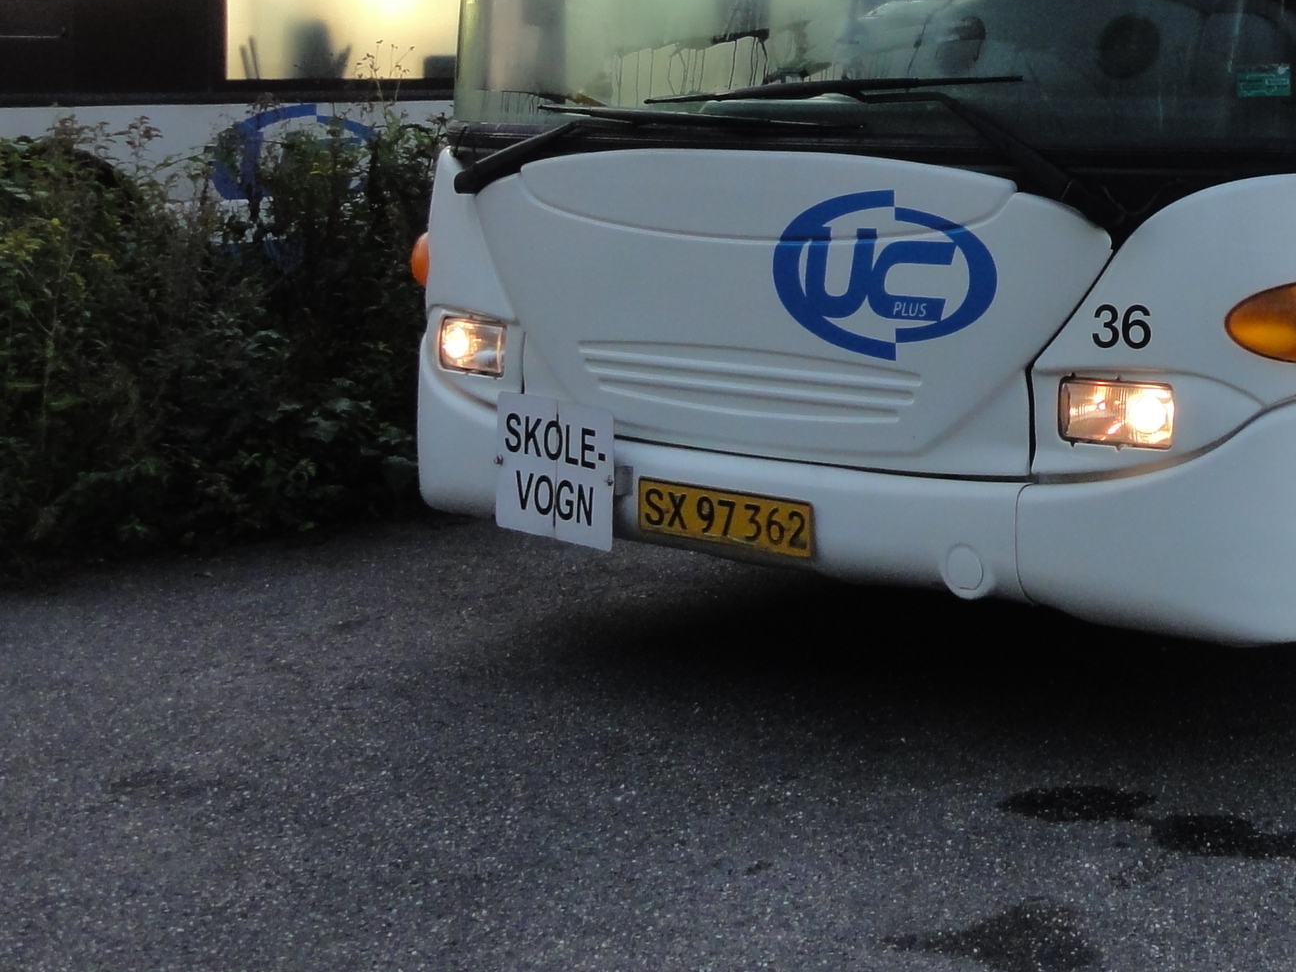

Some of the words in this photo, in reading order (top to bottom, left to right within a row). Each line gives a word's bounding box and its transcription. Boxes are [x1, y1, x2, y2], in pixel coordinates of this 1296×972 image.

[803, 226, 957, 323] UC
[892, 301, 928, 318] PLUS
[1091, 303, 1152, 350] 36
[504, 412, 606, 470] SKOLE-
[515, 469, 595, 527] VOGN
[644, 488, 688, 531] SX
[695, 494, 737, 538] 97
[744, 503, 808, 551] 362
